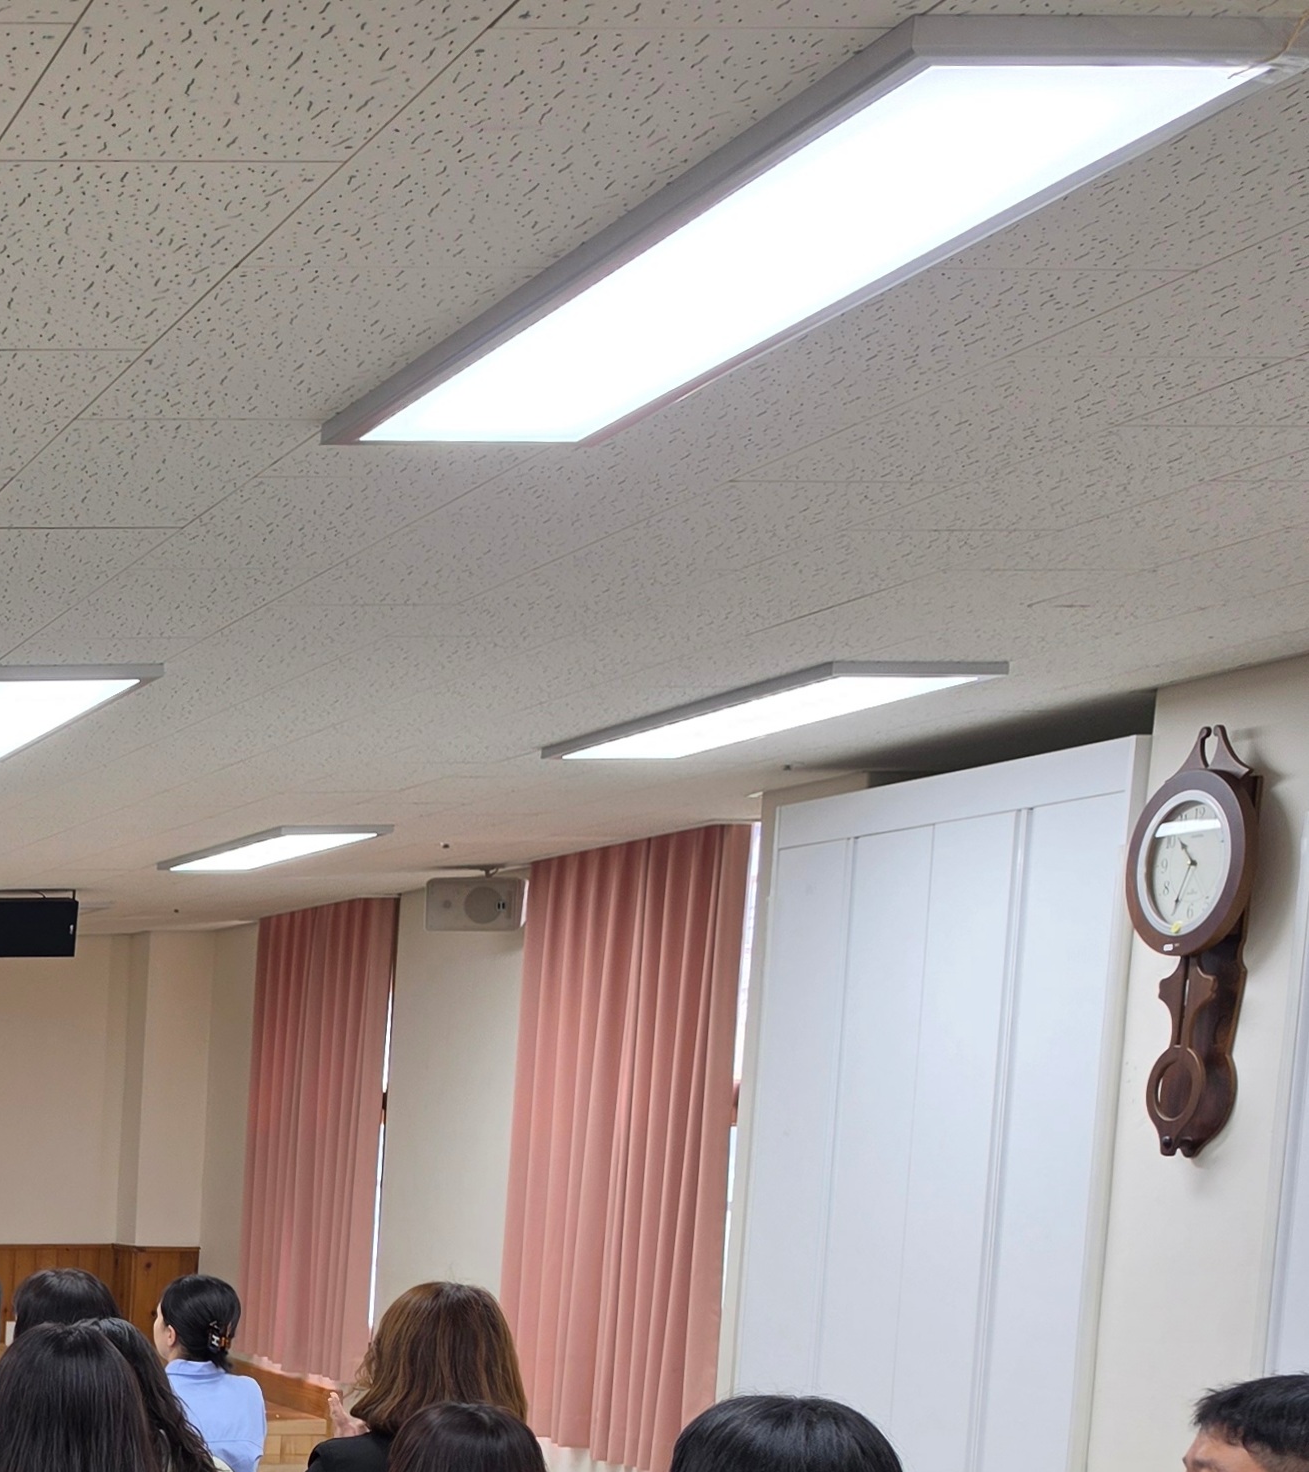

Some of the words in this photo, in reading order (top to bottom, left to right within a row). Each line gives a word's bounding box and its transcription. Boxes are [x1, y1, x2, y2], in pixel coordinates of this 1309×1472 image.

[1161, 858, 1168, 874] 9
[1163, 881, 1170, 895] 8
[1186, 904, 1194, 919] 6
